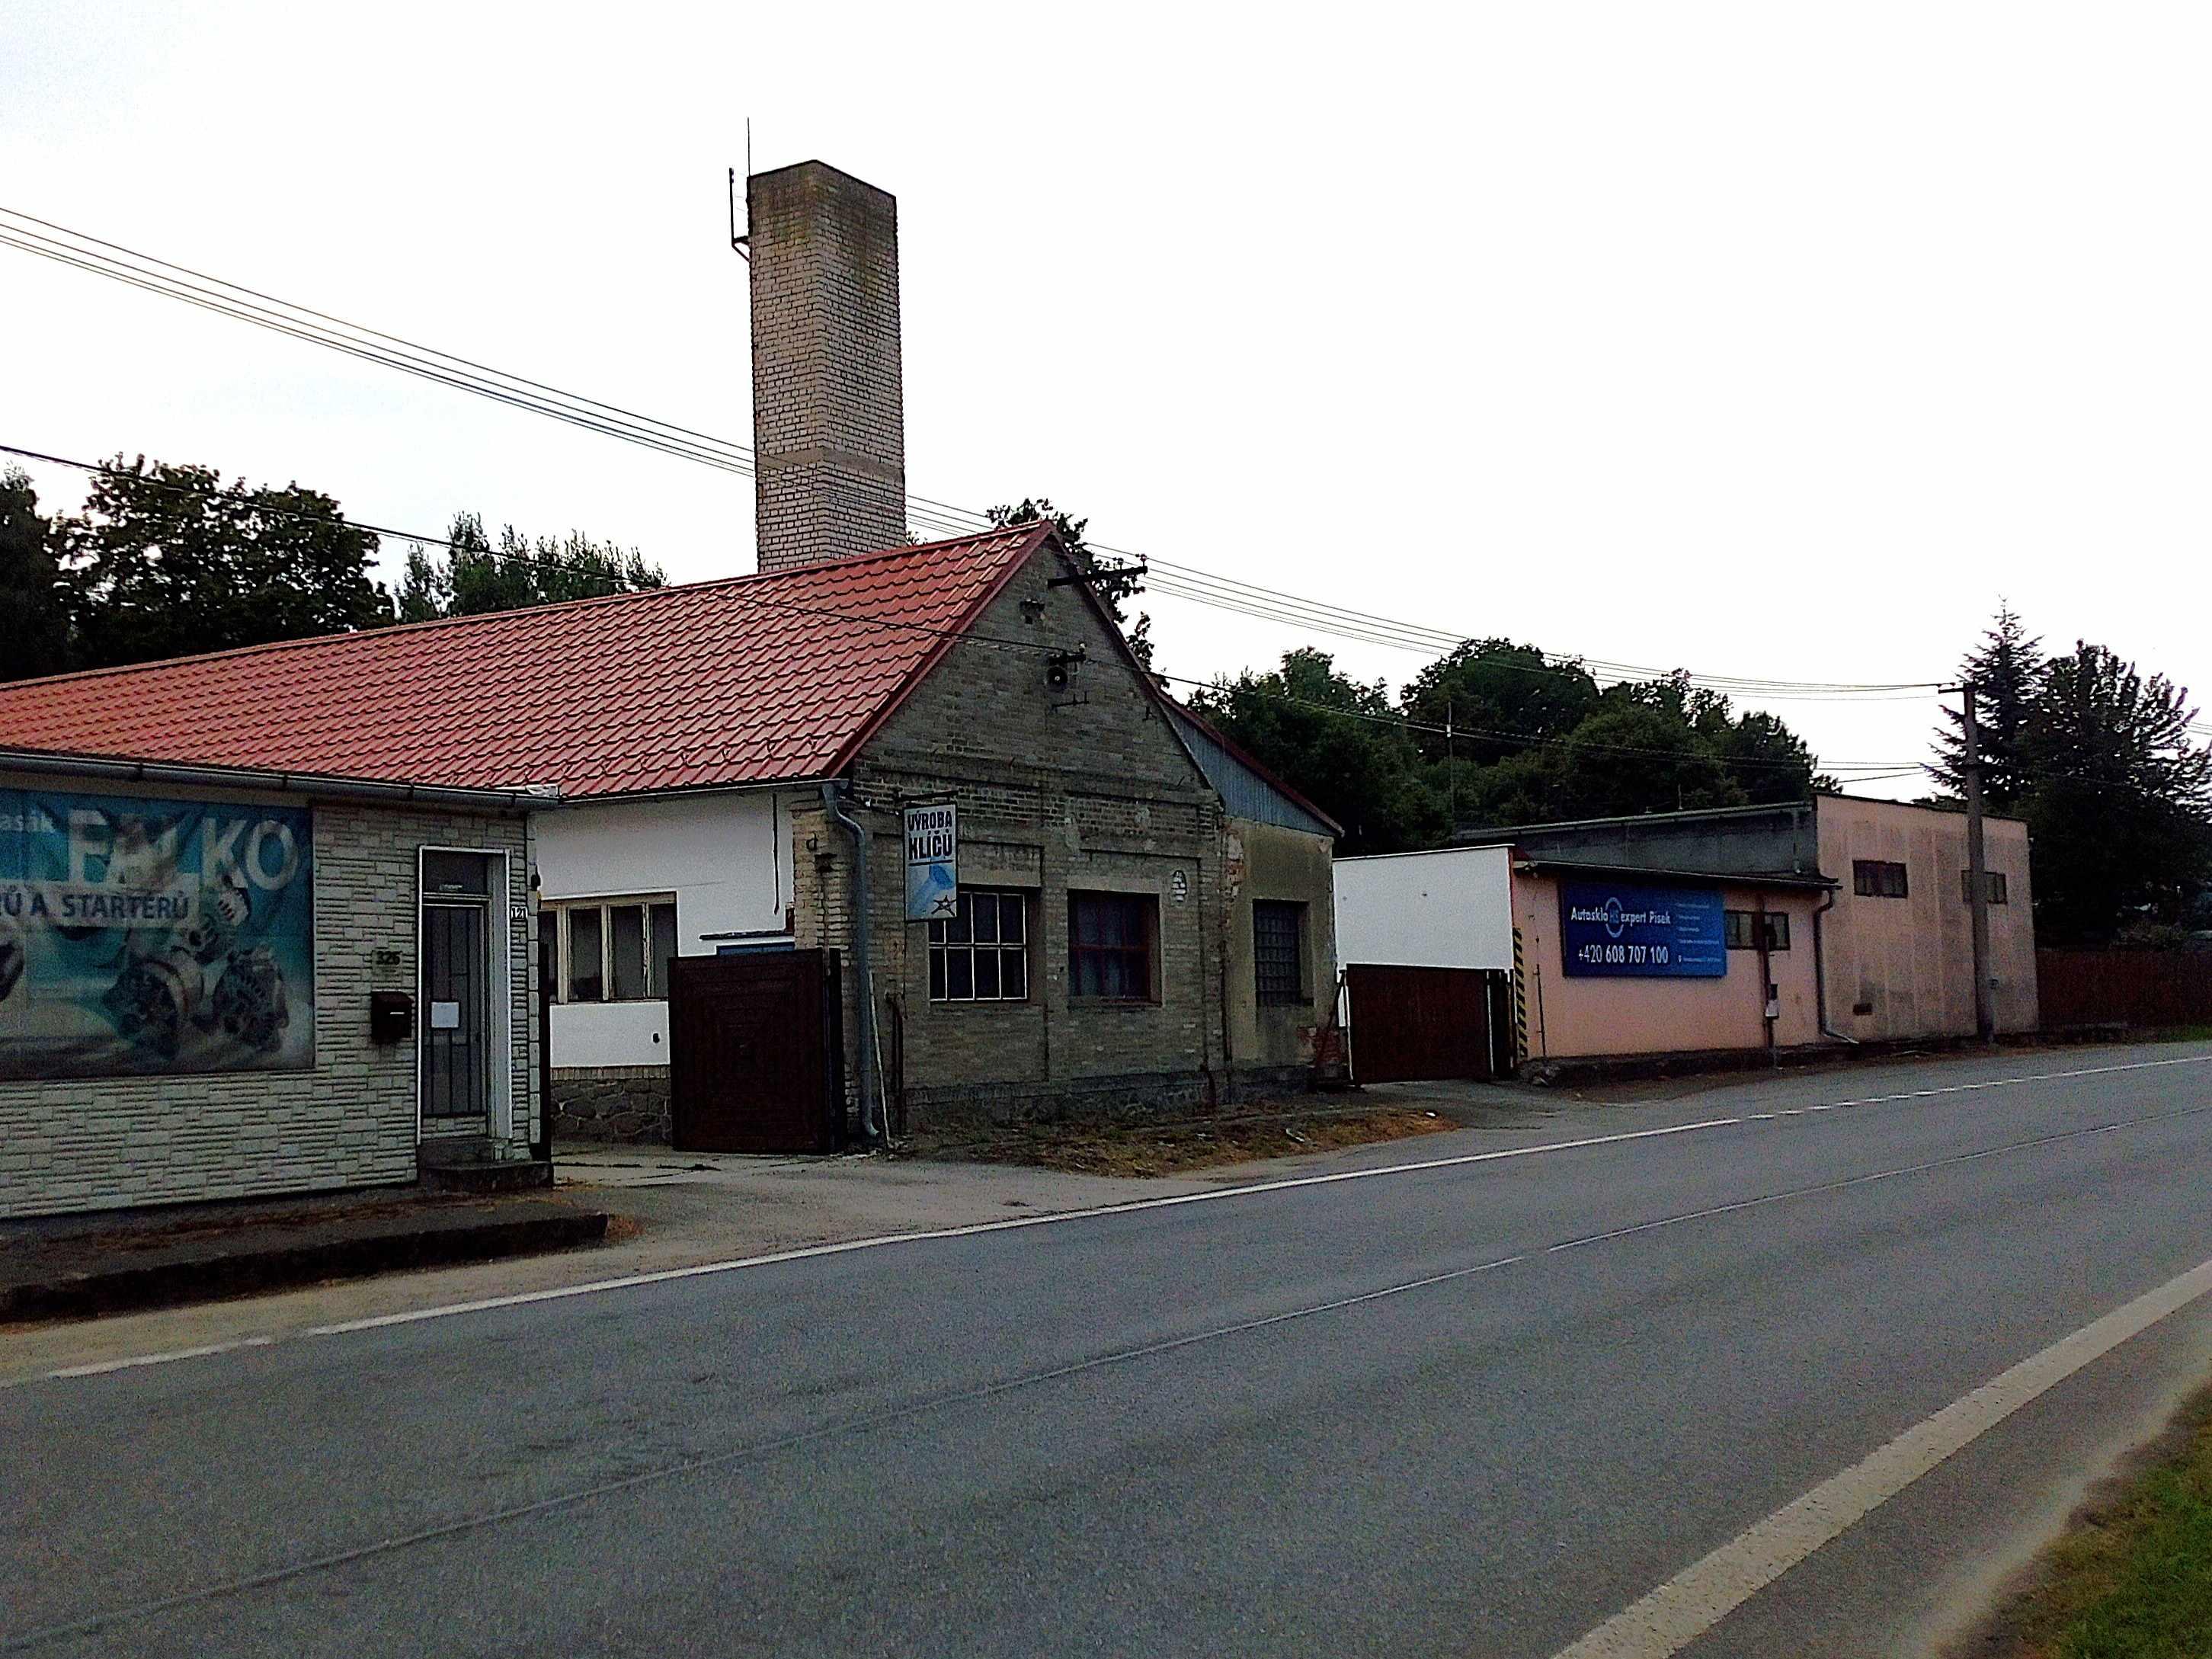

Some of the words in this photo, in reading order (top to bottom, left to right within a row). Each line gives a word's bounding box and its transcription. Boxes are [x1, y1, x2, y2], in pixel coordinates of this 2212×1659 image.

[907, 810, 952, 831] VÝROBA
[908, 829, 952, 860] KLÍČŮ
[30, 892, 48, 917] A
[512, 908, 527, 918] 121
[1570, 907, 1609, 921] Autosklo
[1621, 912, 1646, 927] expert
[1578, 944, 1602, 963] +420
[1605, 944, 1625, 963] 608
[1628, 946, 1647, 964] 707
[1650, 946, 1669, 964] 100
